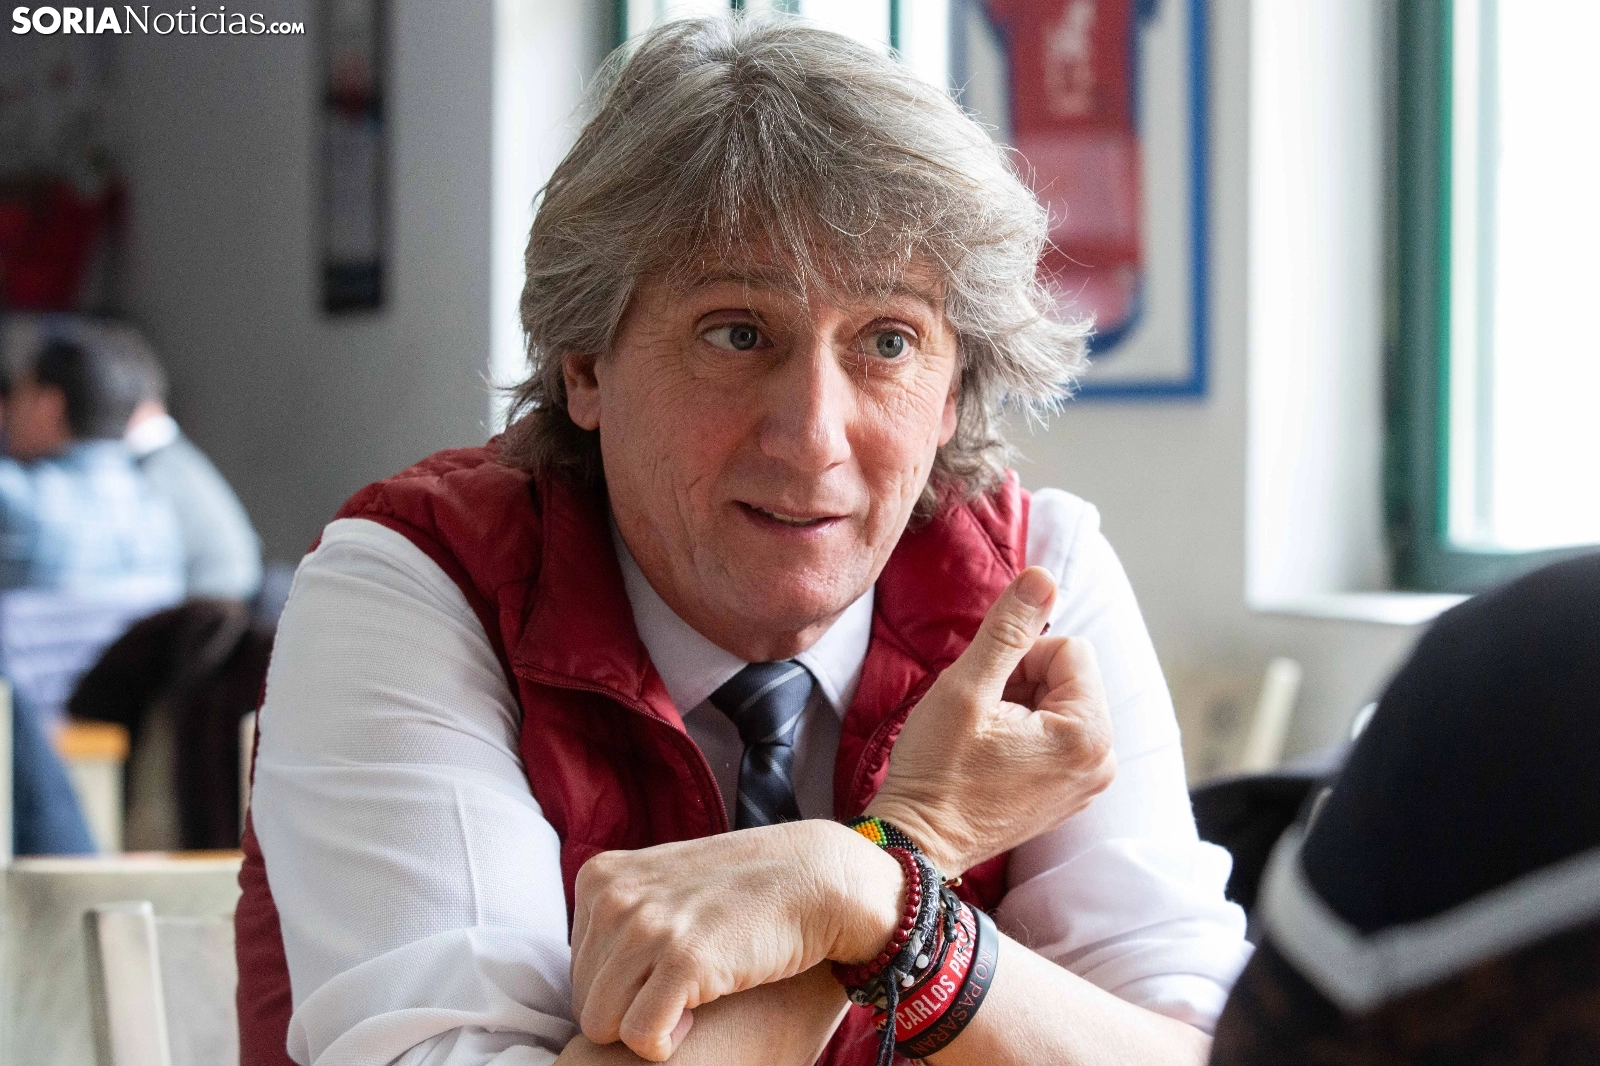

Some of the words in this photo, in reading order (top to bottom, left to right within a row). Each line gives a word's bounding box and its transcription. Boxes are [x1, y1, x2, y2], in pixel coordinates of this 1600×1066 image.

[974, 948, 993, 980] NO
[896, 975, 956, 1030] CARLOS
[910, 980, 983, 1054] PASARAN
